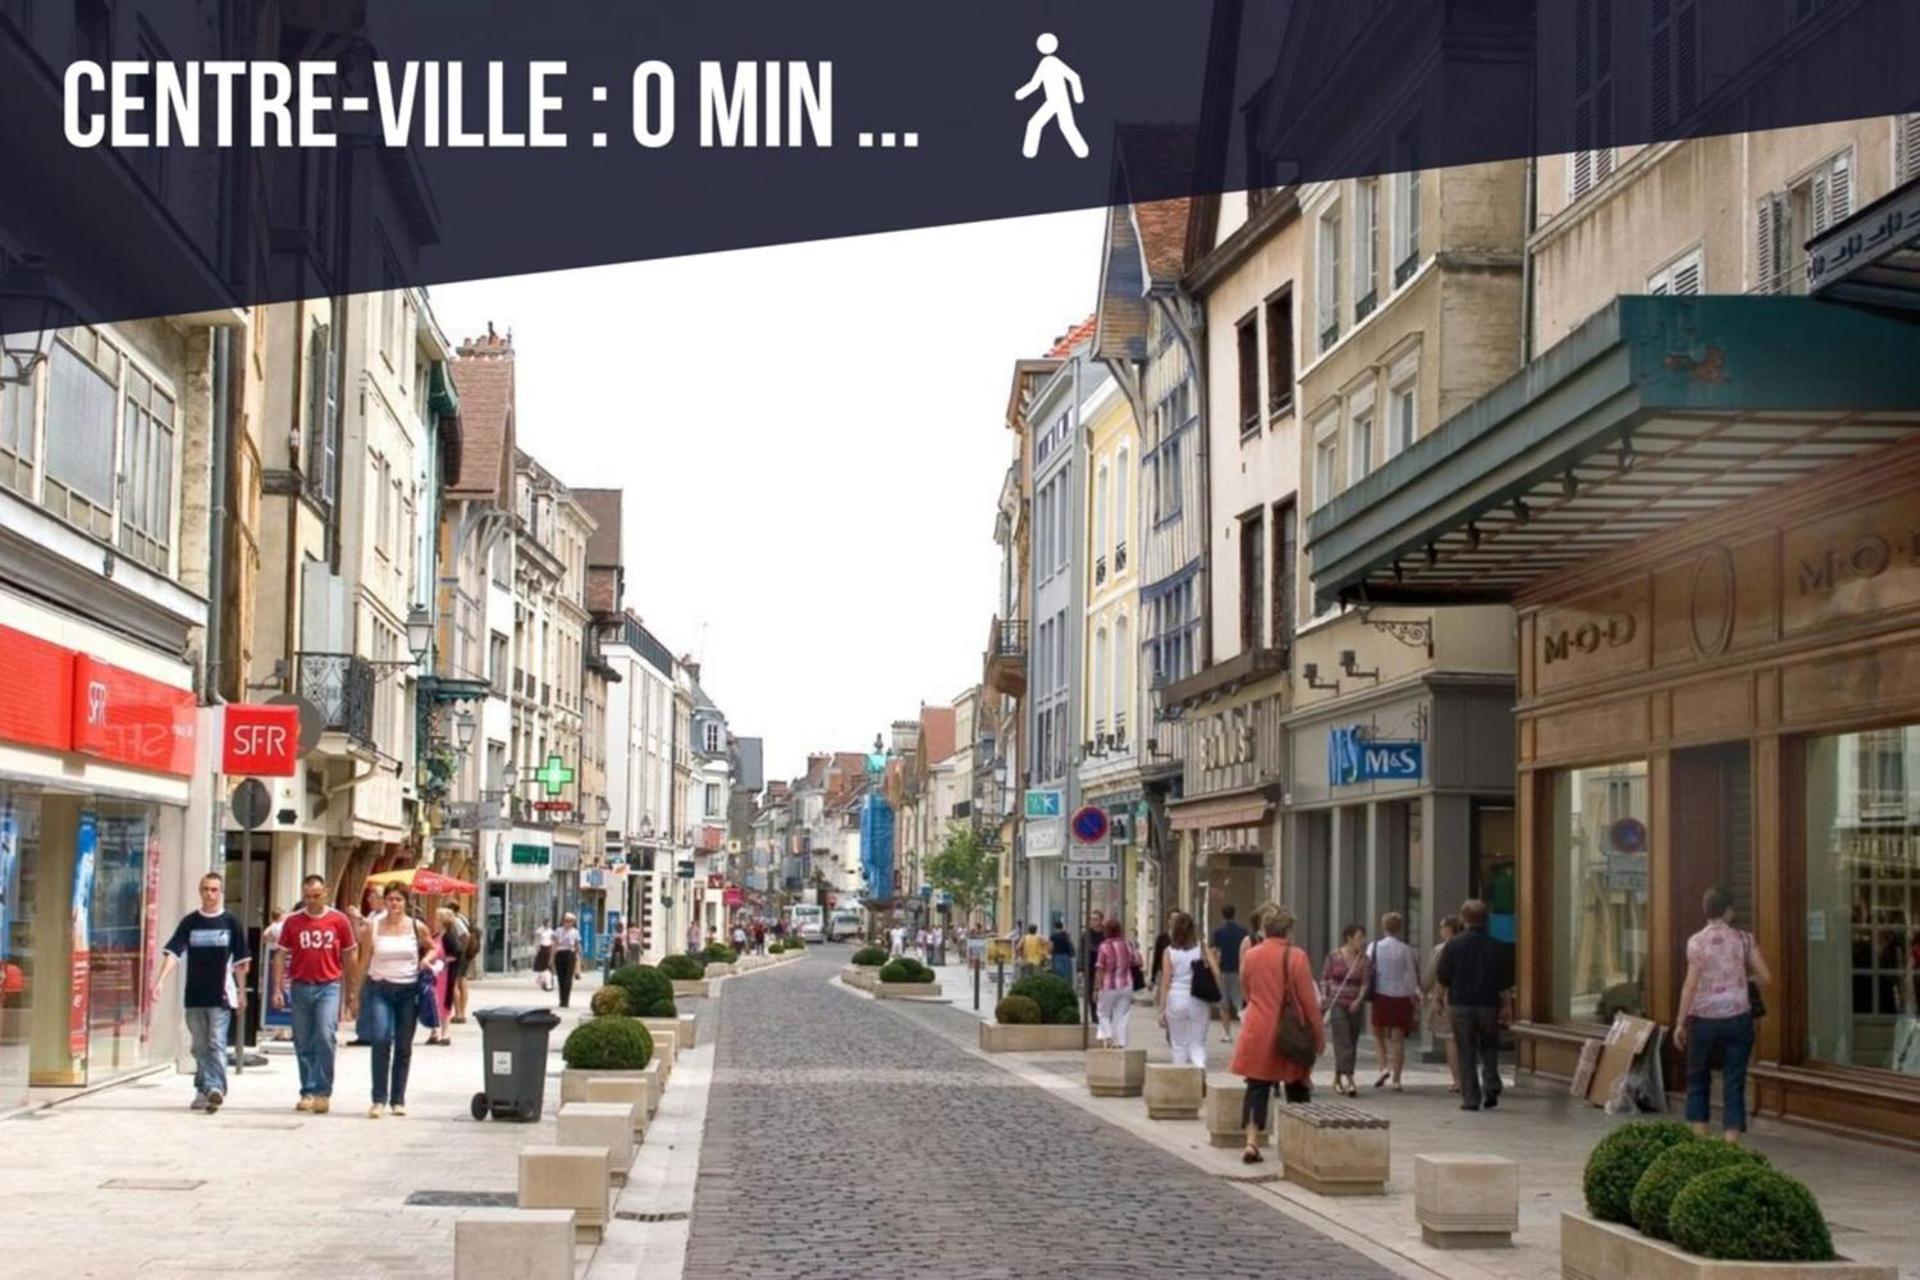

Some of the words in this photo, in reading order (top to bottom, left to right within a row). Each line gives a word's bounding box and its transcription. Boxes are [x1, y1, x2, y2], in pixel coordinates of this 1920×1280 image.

[233, 725, 286, 757] SFR
[1365, 748, 1417, 774] M&S
[1076, 866, 1092, 877] 25
